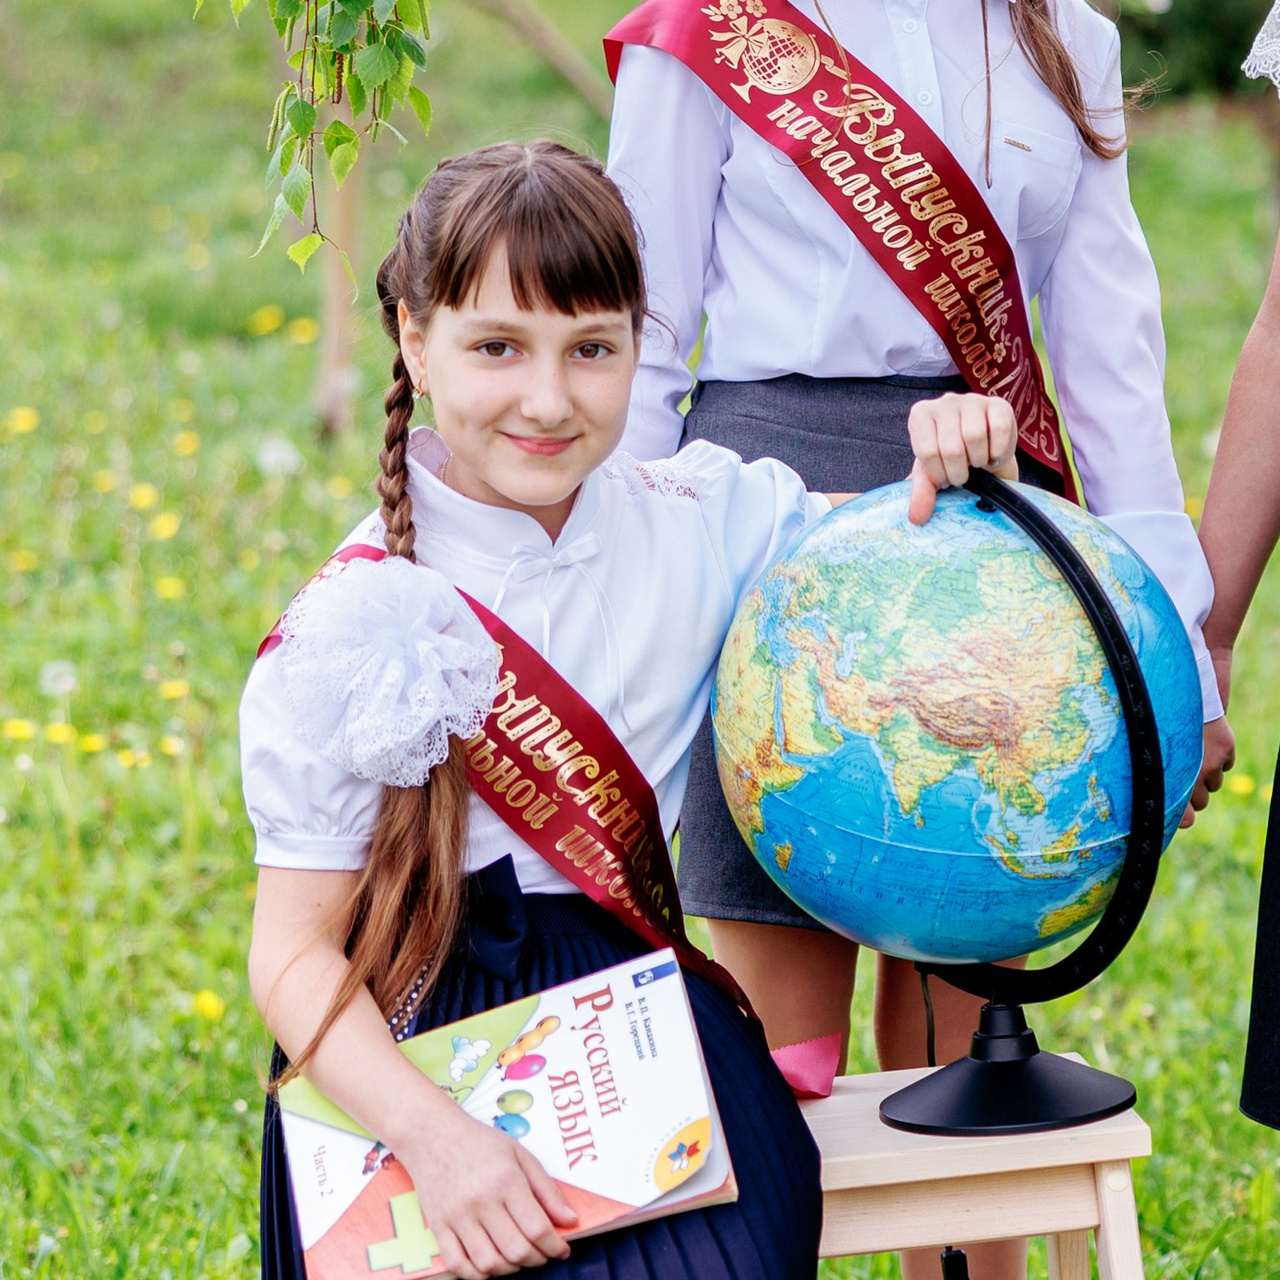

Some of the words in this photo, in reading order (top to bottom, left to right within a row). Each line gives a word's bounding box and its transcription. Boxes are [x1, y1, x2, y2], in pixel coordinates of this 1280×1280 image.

[766, 98, 934, 272] начальной
[924, 272, 999, 389] школы
[811, 81, 1013, 342] Выпускник
[570, 983, 629, 1119] Русский
[313, 1144, 327, 1187] Часть
[320, 1187, 334, 1198] 2
